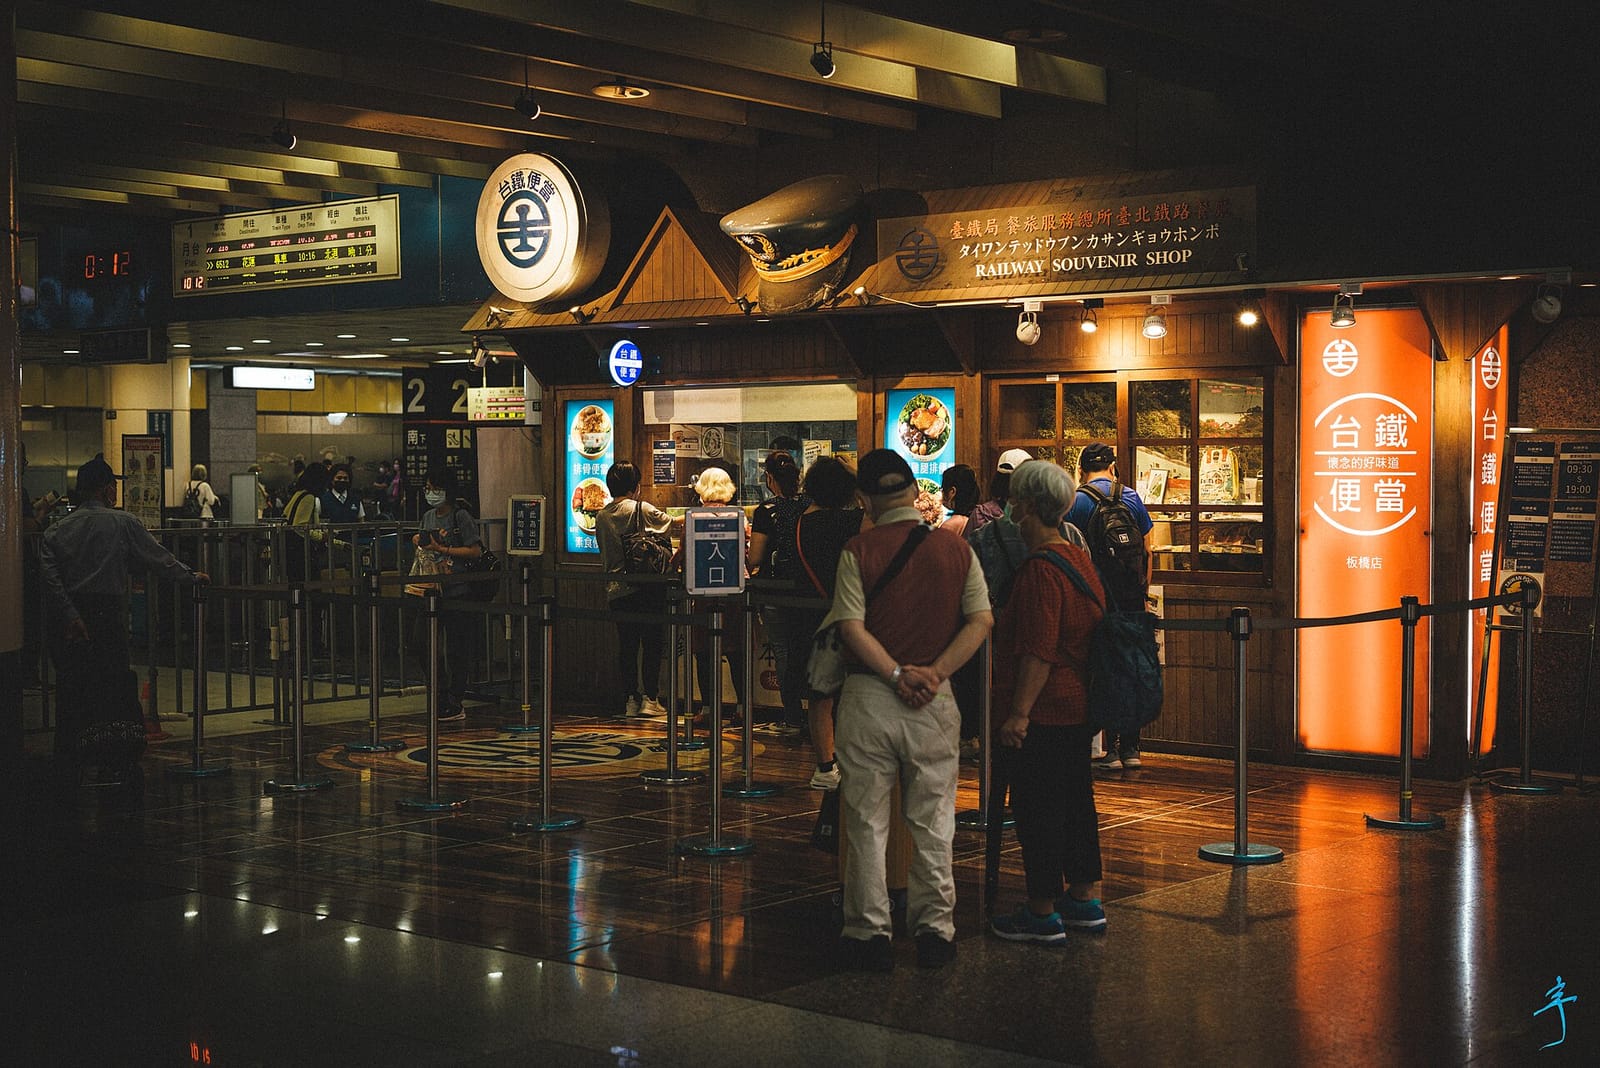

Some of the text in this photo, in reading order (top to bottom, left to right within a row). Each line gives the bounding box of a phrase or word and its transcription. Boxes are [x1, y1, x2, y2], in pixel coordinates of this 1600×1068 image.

[498, 170, 556, 203] 台鐵便當
[298, 251, 316, 262] 10:16
[975, 248, 1193, 278] RAILWAY SOUVENIR SHOP
[407, 378, 427, 413] 2
[451, 379, 468, 413] 2
[1329, 412, 1409, 449] 台鐵
[1327, 455, 1400, 470] 懷念的好味道
[1566, 464, 1593, 474] 09:30
[1329, 477, 1407, 514] 便當
[1480, 407, 1498, 583] 台鐵便當
[1565, 484, 1592, 494] 19:00
[708, 542, 726, 585] 入口
[1346, 555, 1383, 569] 板橋店
